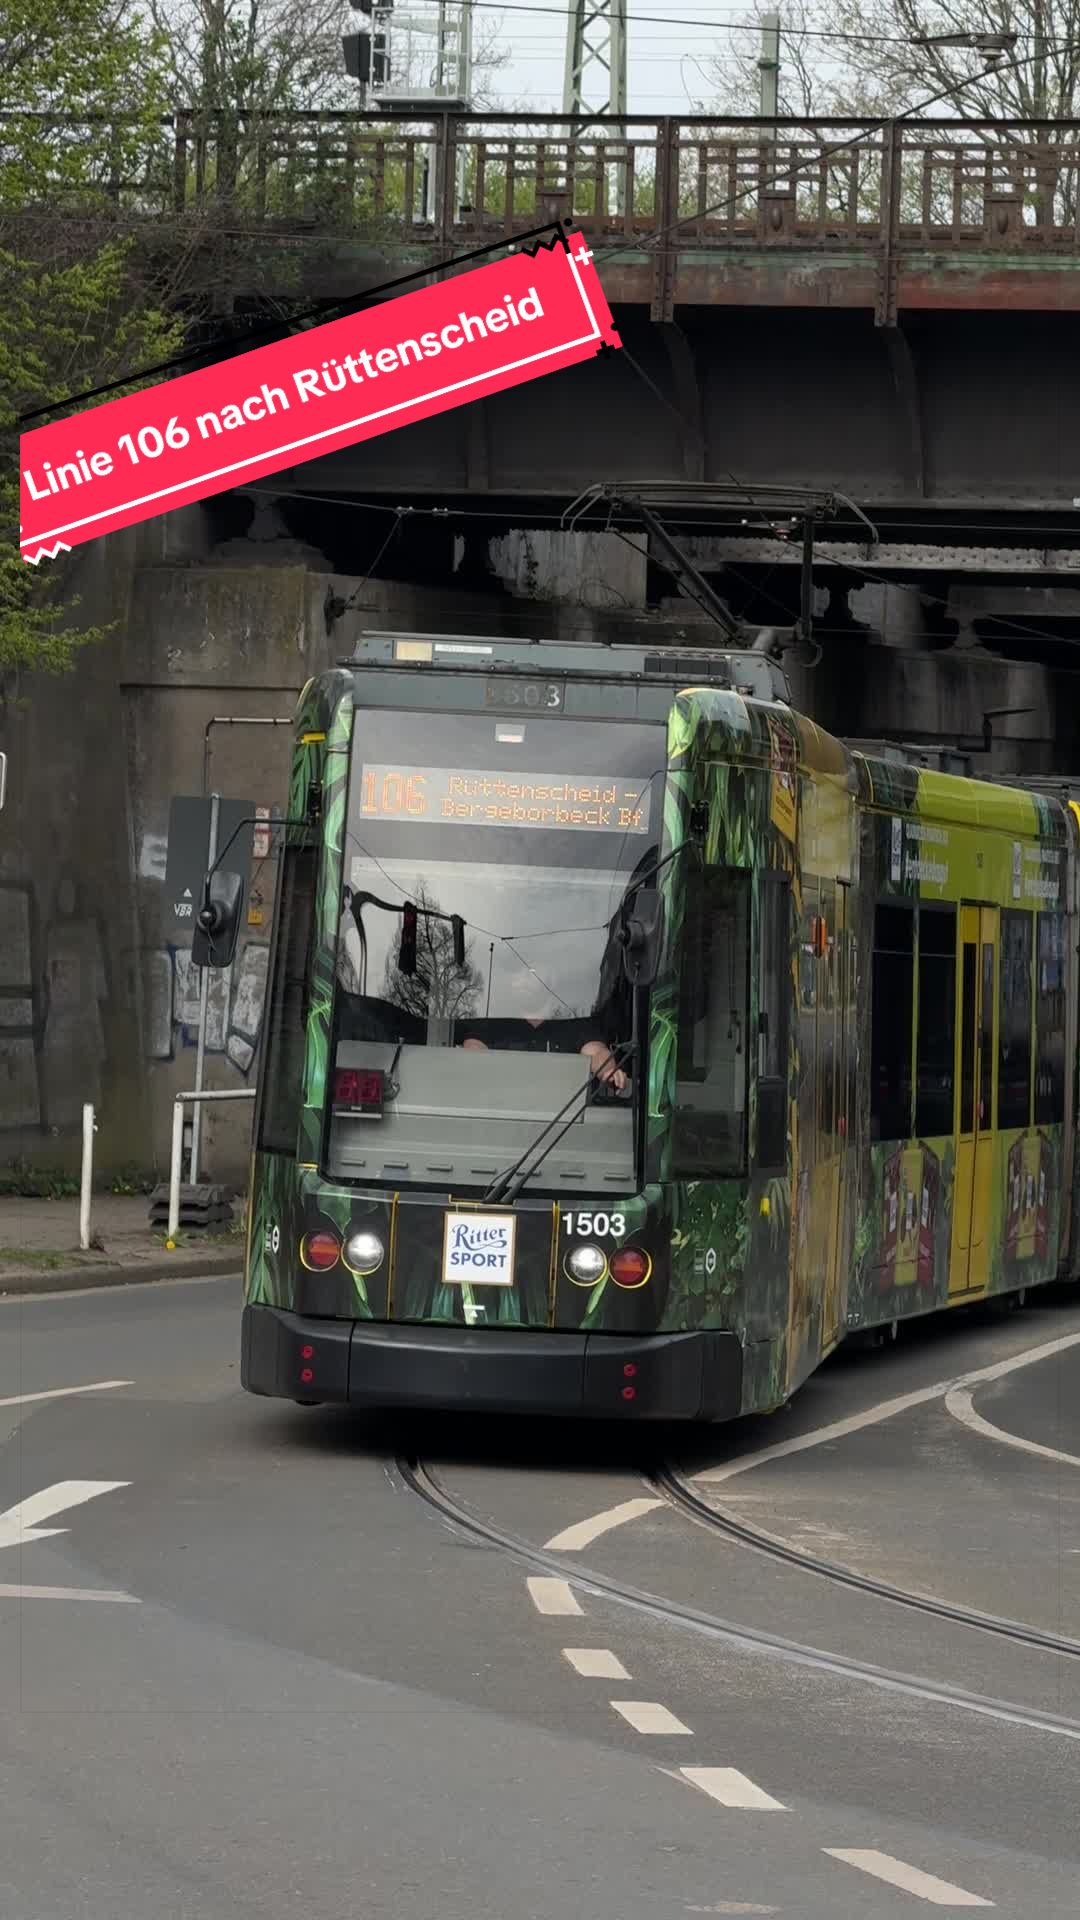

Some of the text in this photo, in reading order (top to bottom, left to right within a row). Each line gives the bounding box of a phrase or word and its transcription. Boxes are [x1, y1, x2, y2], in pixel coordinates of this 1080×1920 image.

[361, 771, 427, 816] 106
[448, 775, 617, 804] Rüttenscheid
[440, 798, 644, 827] Bergeborbeck Bf
[562, 1206, 626, 1237] 1503
[452, 1223, 508, 1251] Ritter
[450, 1251, 508, 1268] SPORT
